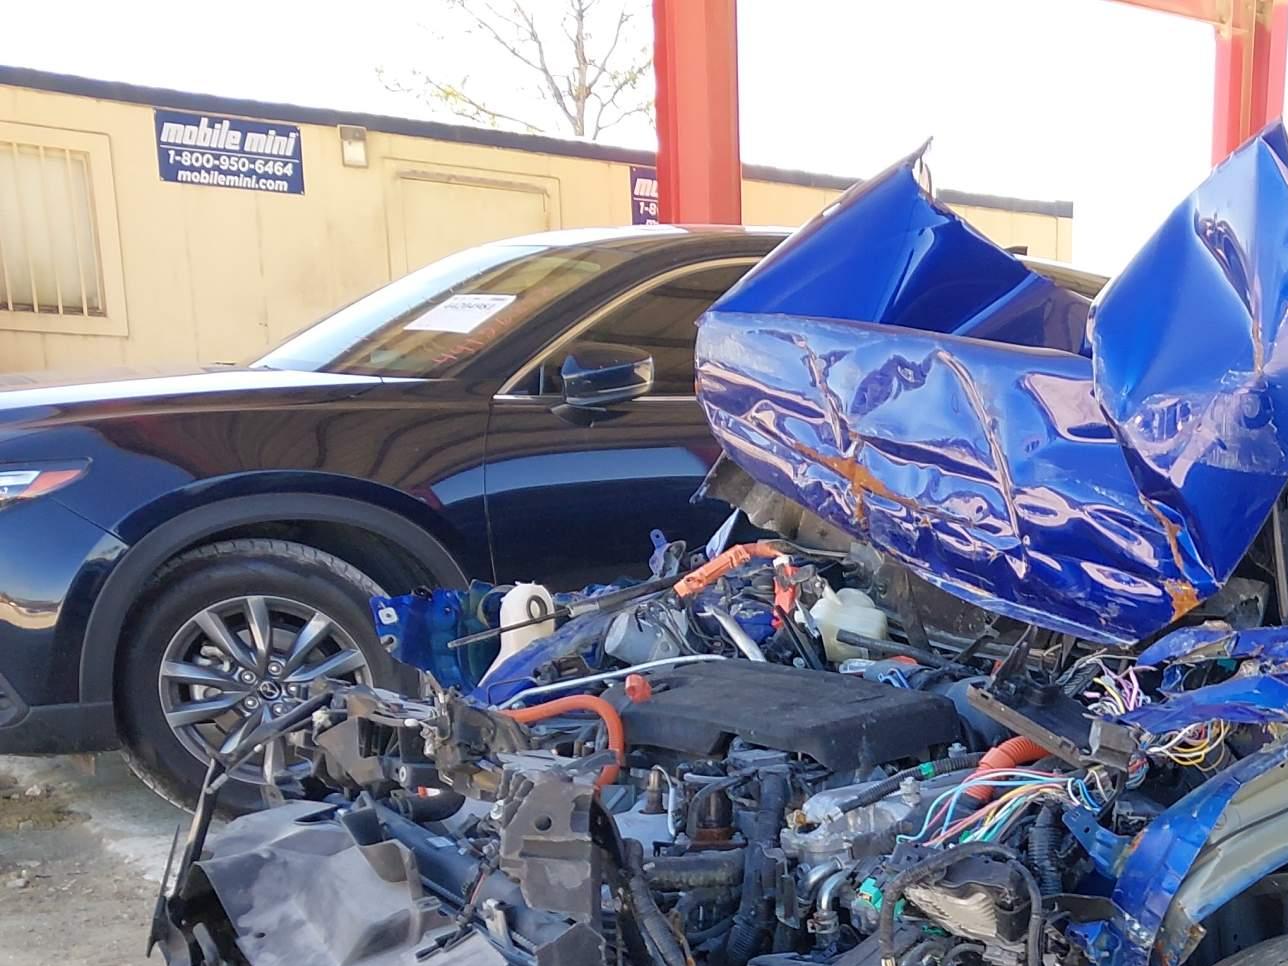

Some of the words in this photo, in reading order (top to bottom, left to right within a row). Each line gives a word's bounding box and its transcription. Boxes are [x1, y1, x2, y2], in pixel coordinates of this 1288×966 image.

[160, 117, 242, 150] mobile
[244, 129, 296, 156] mini
[167, 149, 293, 177] 1-800-950-6464
[177, 169, 288, 192] mobilemini.com
